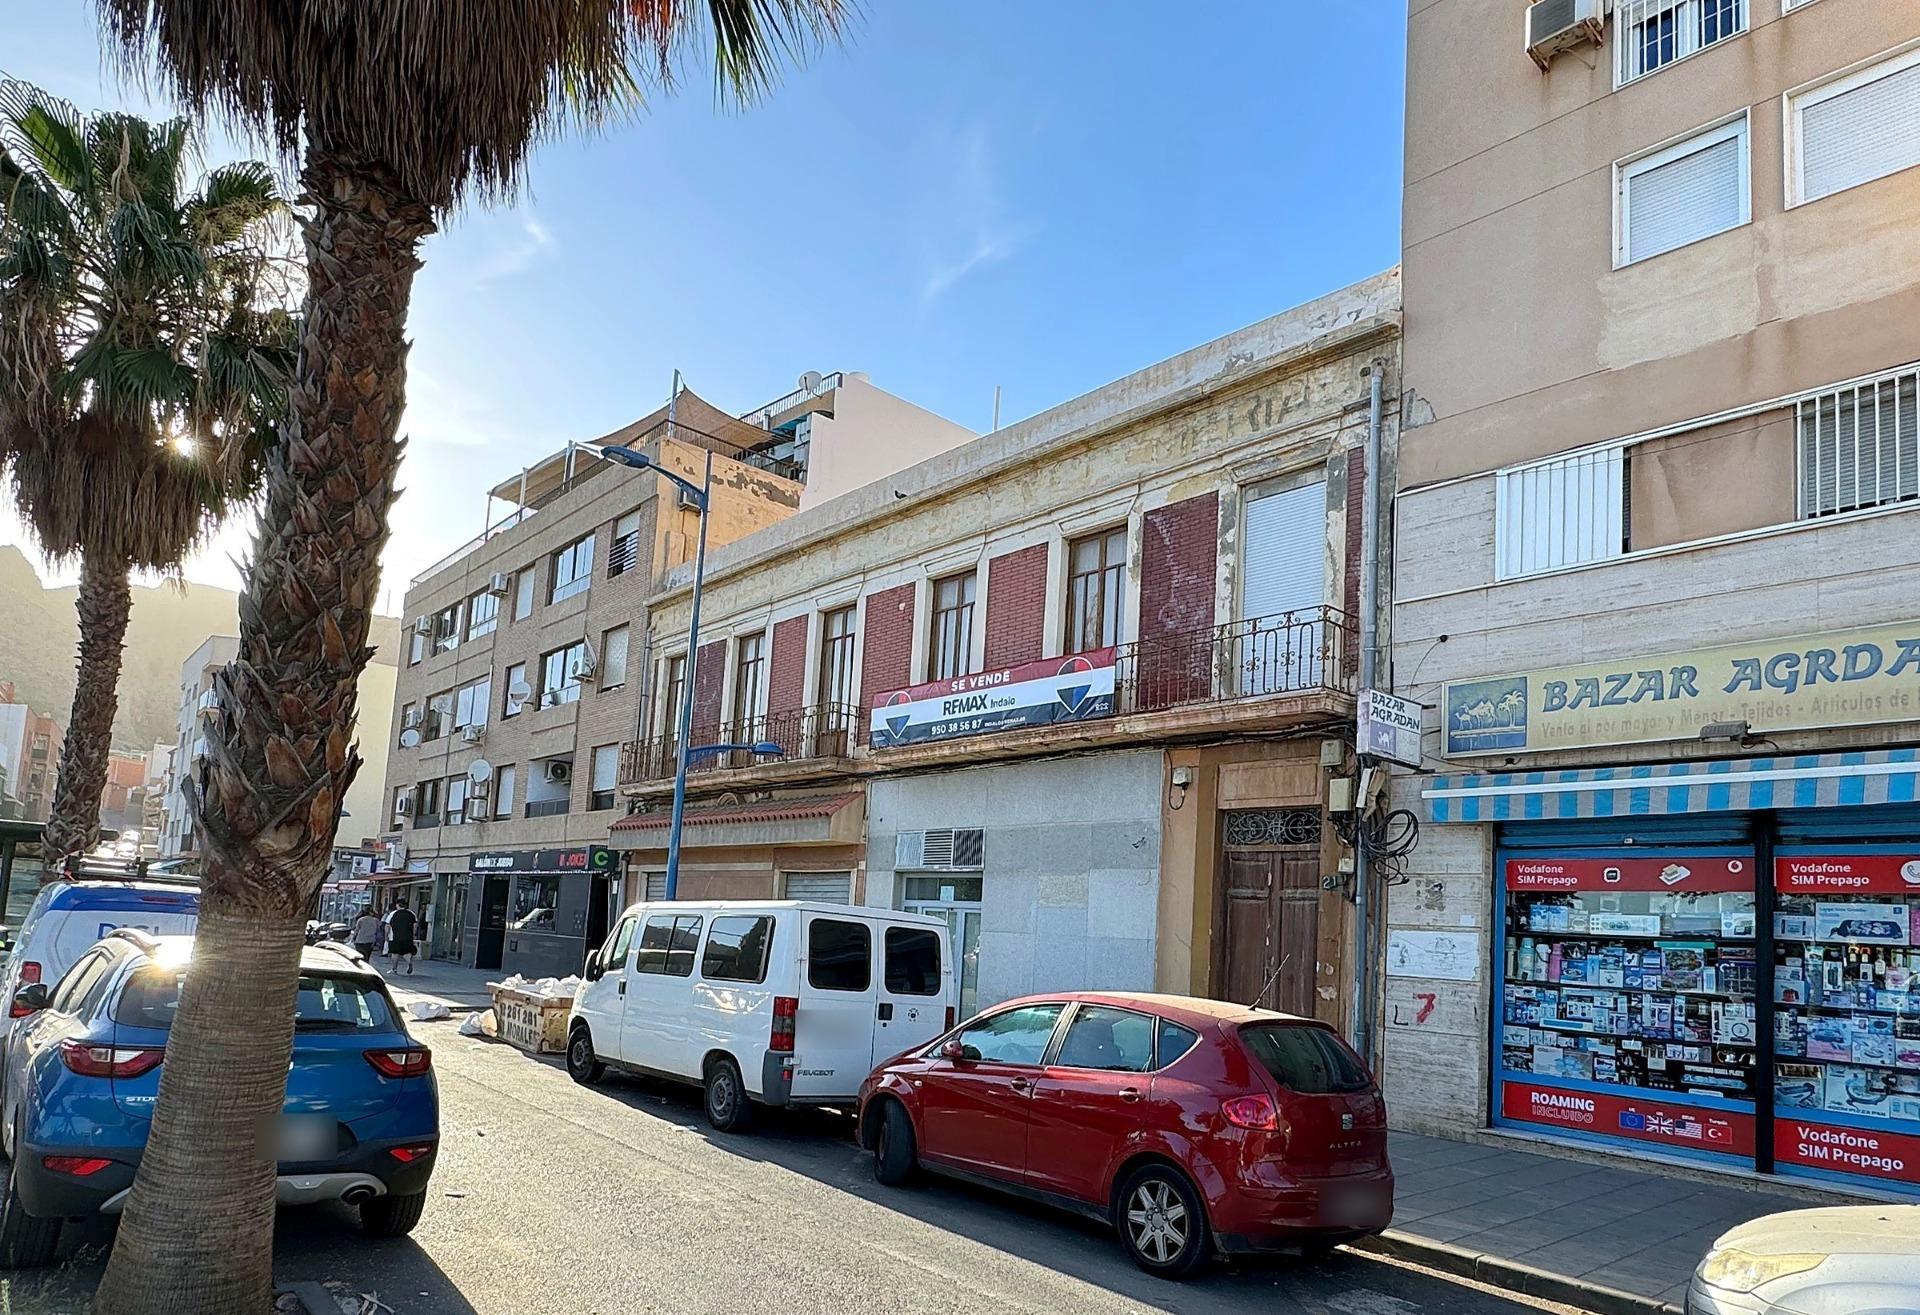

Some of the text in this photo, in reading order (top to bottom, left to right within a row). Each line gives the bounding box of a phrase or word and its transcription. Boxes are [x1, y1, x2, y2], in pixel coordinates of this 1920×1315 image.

[951, 671, 1010, 692] SE VENDE
[1543, 638, 1920, 712] BAZAR AGRDA
[943, 694, 1016, 716] REMAX Indalo
[1372, 692, 1405, 713] BAZAR
[1621, 716, 1663, 733] mayor
[1667, 714, 1674, 727] y
[1681, 709, 1724, 726] Menor
[1741, 700, 1791, 722] Tejidos
[1890, 688, 1909, 707] de
[931, 725, 946, 735] 950
[948, 722, 957, 732] 38
[960, 720, 970, 731] 56
[972, 718, 983, 729] 87
[1371, 705, 1420, 731] AGRADAN
[1518, 865, 1563, 873] Vodafone
[1791, 863, 1851, 873] Vodafone
[1323, 875, 1336, 889] 21
[1518, 876, 1578, 886] SIM Prepago
[1791, 875, 1870, 886] SIM Prepago
[797, 1069, 835, 1077] PEUGEOT
[1531, 1092, 1595, 1111] ROAMING
[1532, 1105, 1593, 1123] INCLUIDO
[1798, 1127, 1879, 1149] Vodafone
[1798, 1143, 1904, 1171] SIM Prepago
